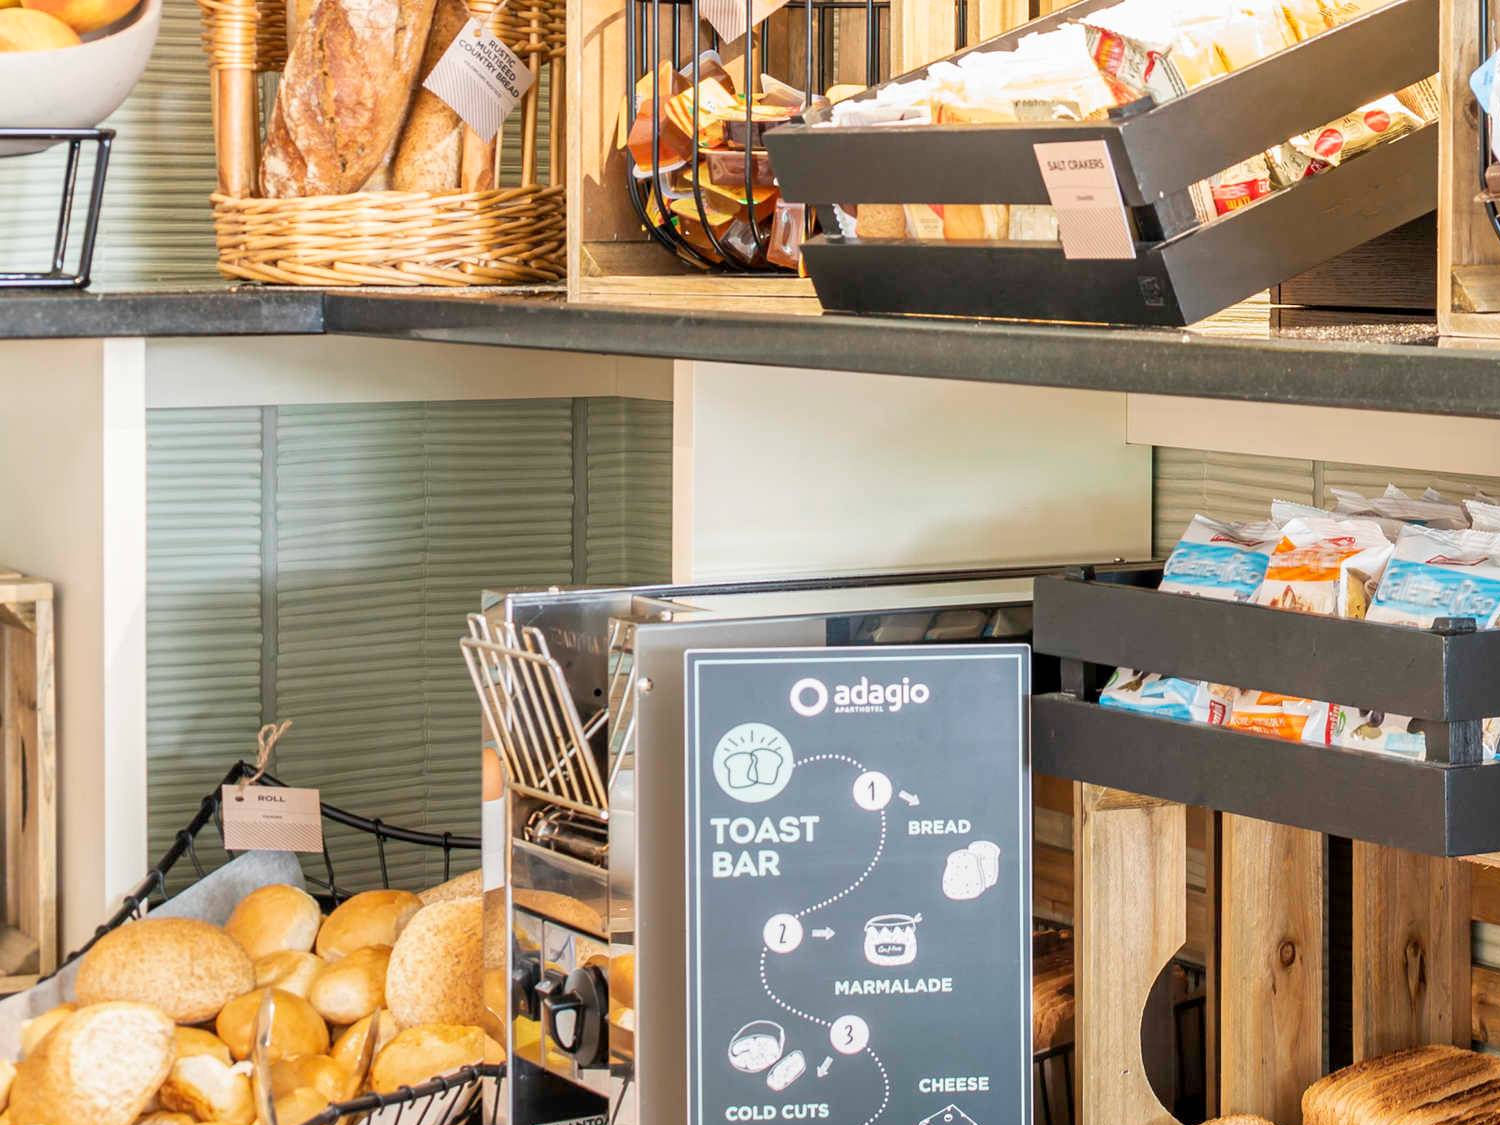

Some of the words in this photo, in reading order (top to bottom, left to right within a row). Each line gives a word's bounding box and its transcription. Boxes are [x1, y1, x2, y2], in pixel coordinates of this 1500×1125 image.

[475, 41, 517, 81] MULTISEED
[488, 39, 516, 68] RUSTIC
[458, 39, 497, 74] COUNTRY
[495, 72, 520, 98] BREAD
[1047, 160, 1065, 171] SALT
[1068, 158, 1105, 170] CRAKERS
[833, 676, 930, 712] adagio
[257, 794, 286, 803] ROLL
[867, 781, 877, 802] 1
[710, 815, 820, 844] TOAST
[908, 819, 971, 835] BREAD
[711, 850, 781, 878] BAR
[778, 923, 787, 944] 2
[834, 977, 953, 995] MARMALADE
[844, 1024, 854, 1045] 3
[918, 1076, 989, 1093] CHEESE
[725, 1104, 776, 1121] COLD
[782, 1103, 830, 1120] CUTS
